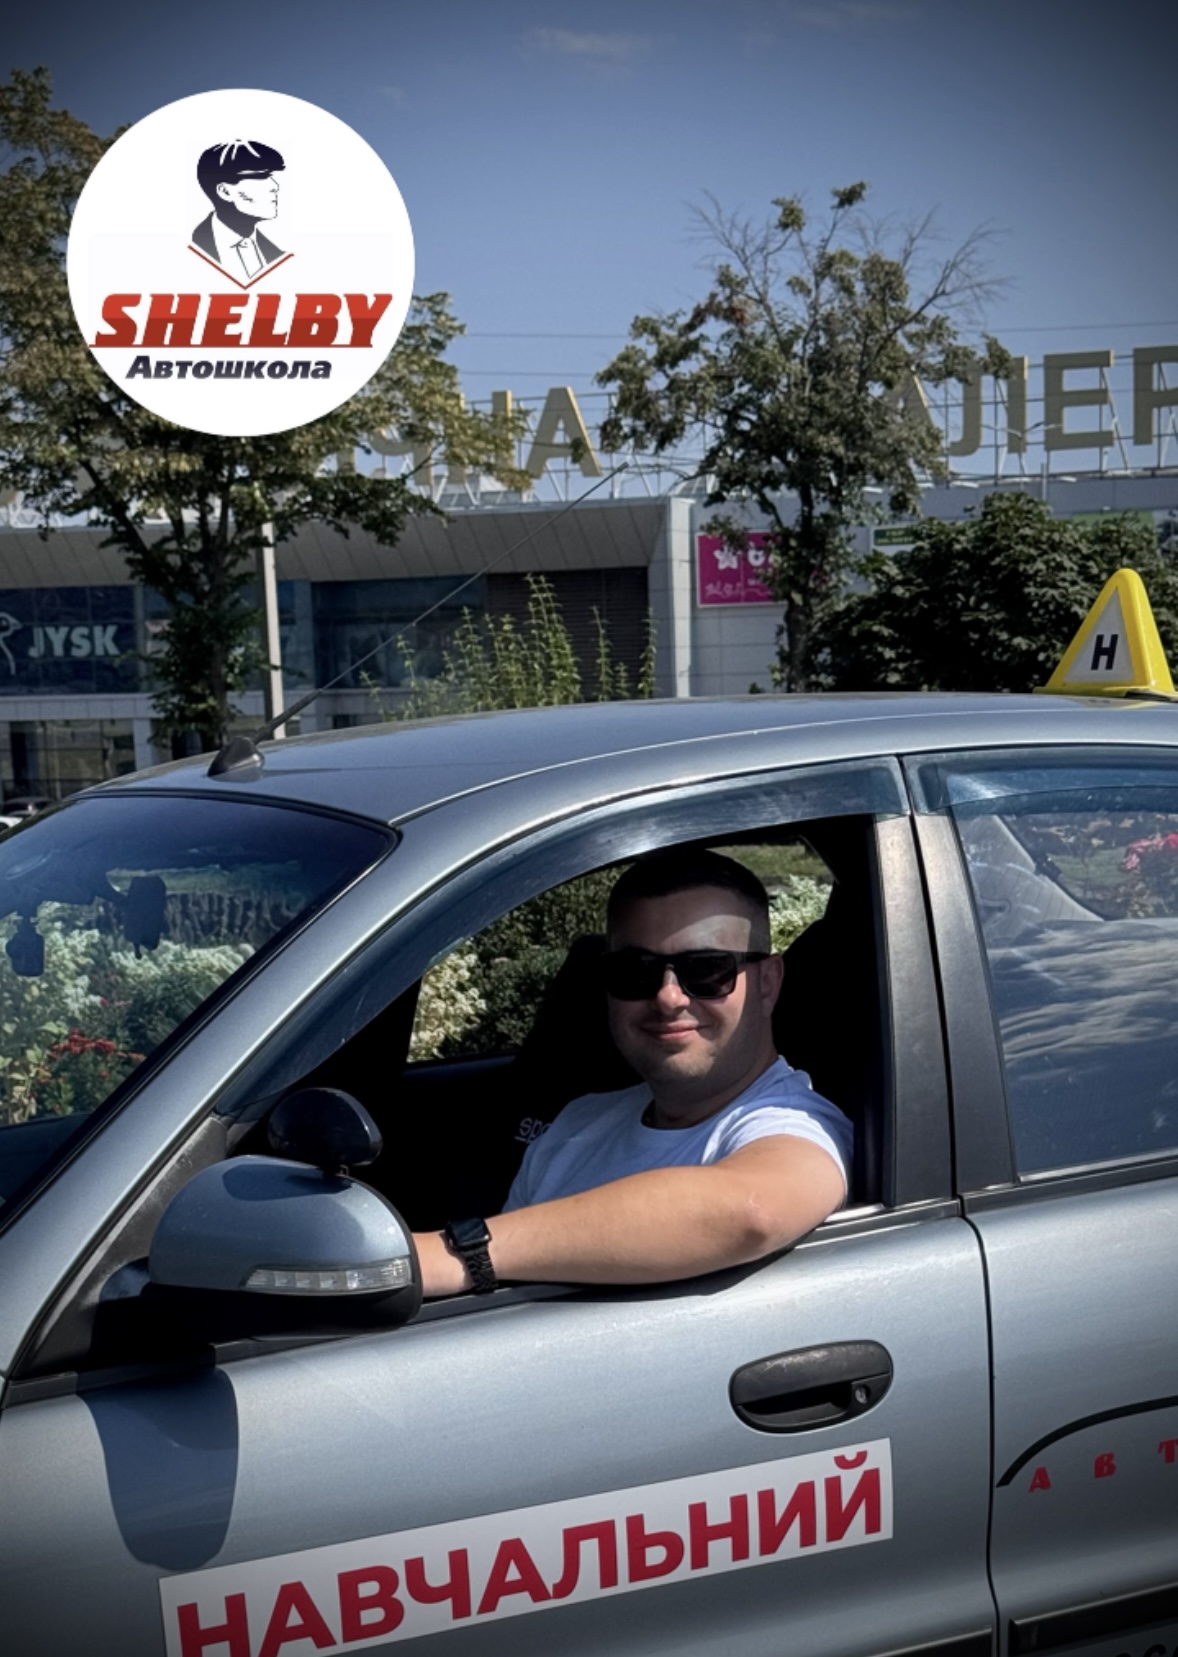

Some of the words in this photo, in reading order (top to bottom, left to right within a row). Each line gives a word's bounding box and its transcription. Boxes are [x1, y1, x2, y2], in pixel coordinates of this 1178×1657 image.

[28, 624, 120, 658] JYSK
[1090, 633, 1119, 671] Н
[176, 1450, 882, 1657] НАВЧАЛЬНИЙ
